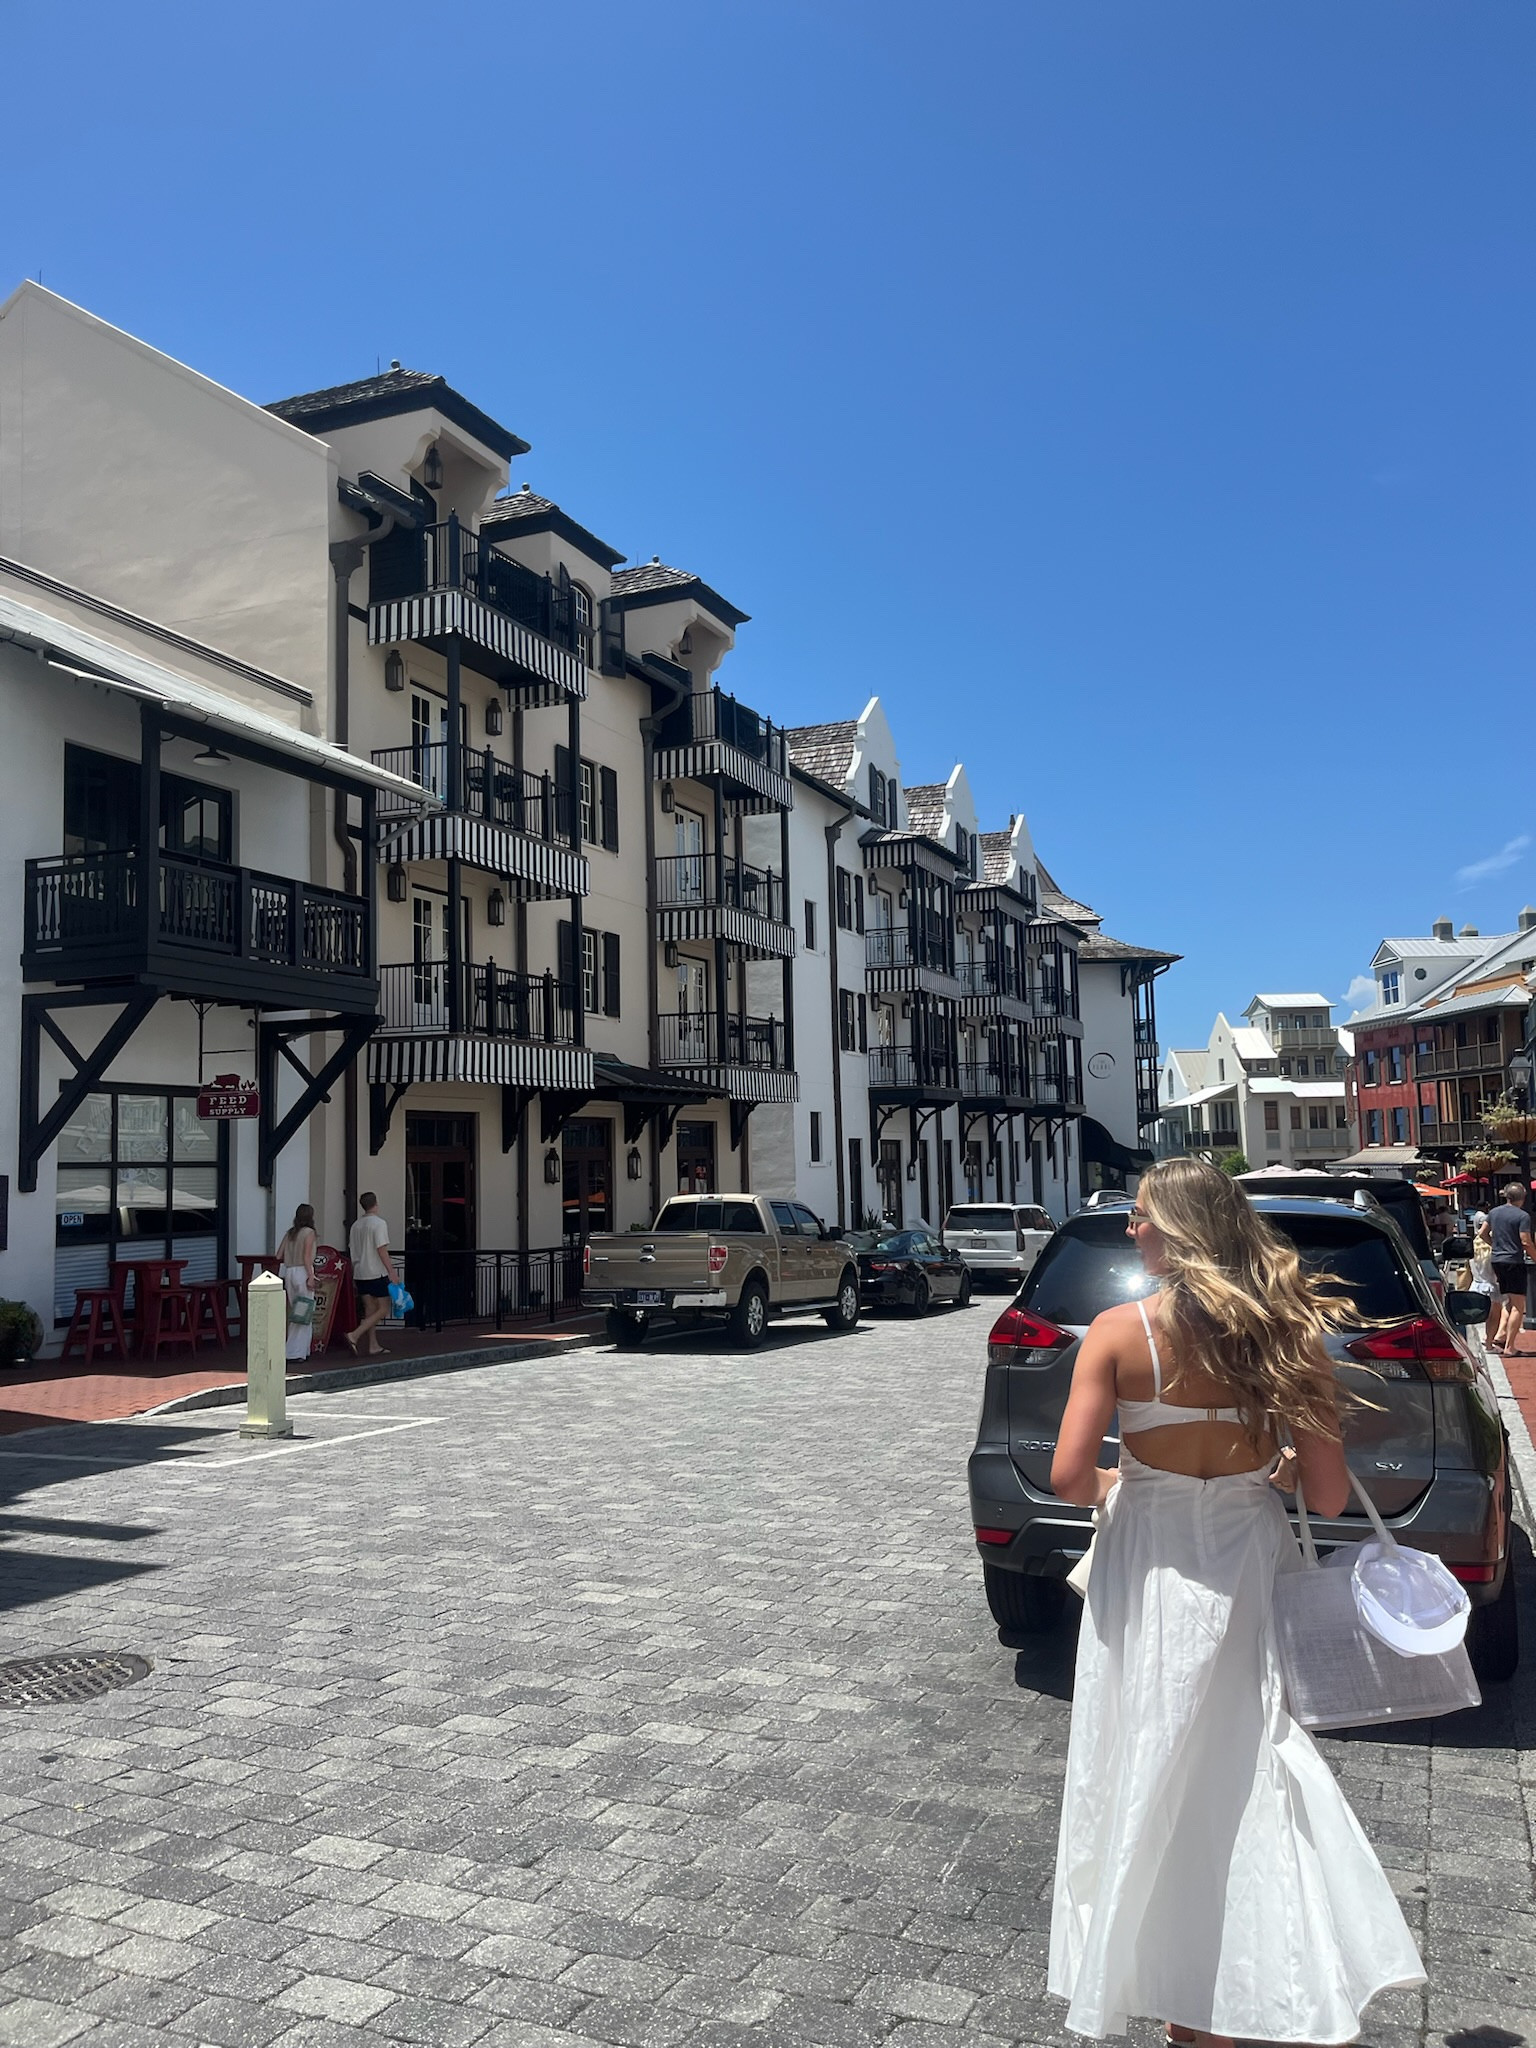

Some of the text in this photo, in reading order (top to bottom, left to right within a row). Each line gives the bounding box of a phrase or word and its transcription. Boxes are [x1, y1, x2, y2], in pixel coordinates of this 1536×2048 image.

[209, 1095, 247, 1106] FEED
[209, 1107, 246, 1115] SUPPLY
[63, 1215, 82, 1224] OPEN
[1375, 1462, 1403, 1471] SV
